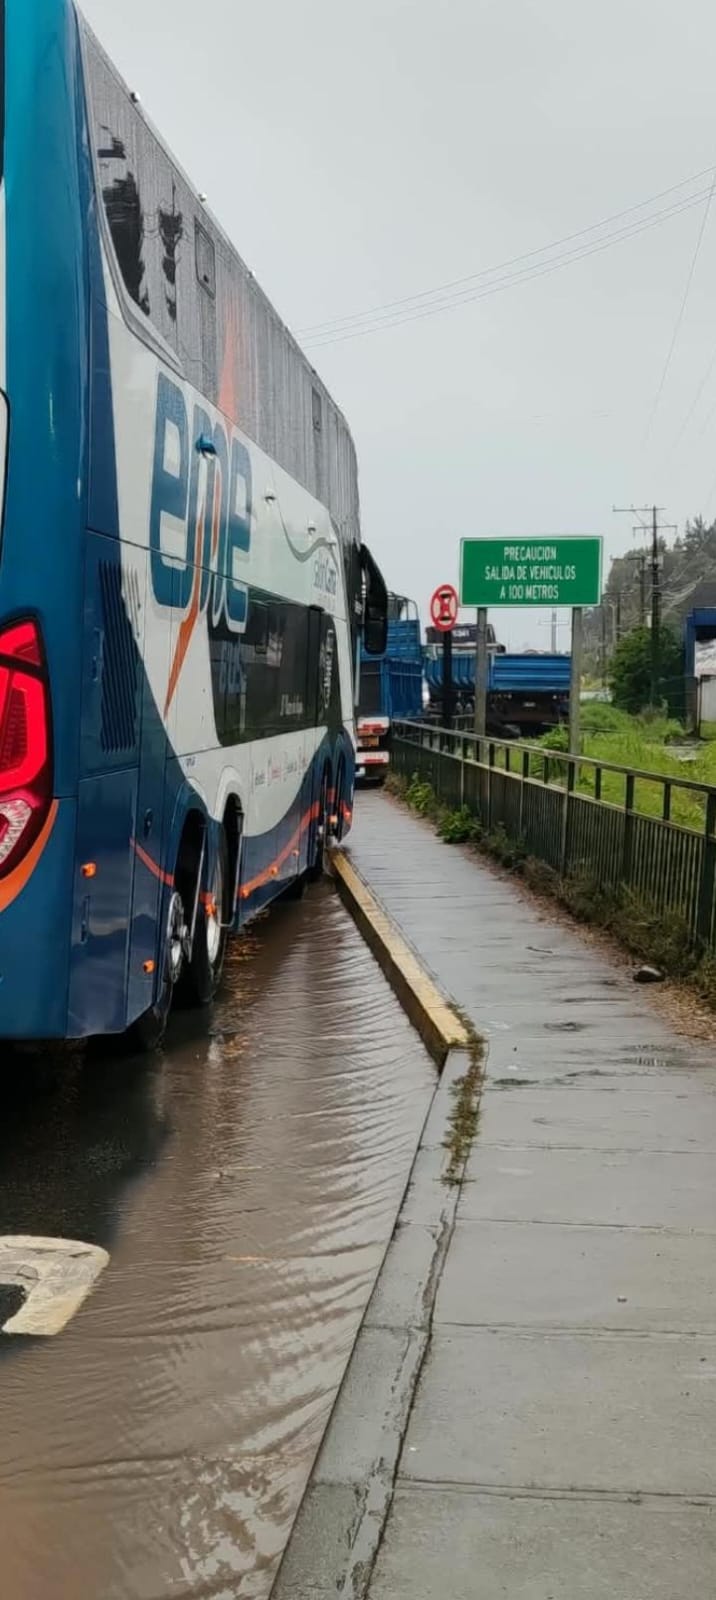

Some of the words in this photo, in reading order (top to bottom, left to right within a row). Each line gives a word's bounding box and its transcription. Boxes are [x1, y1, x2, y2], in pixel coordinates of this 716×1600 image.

[150, 371, 252, 628] eme
[503, 546, 557, 561] PRECAUCION
[485, 565, 515, 581] SALIDA
[517, 565, 528, 580] DE
[529, 565, 576, 580] VEHICULOS
[500, 585, 506, 600] A
[508, 585, 524, 600] 100
[525, 584, 559, 600] METROS
